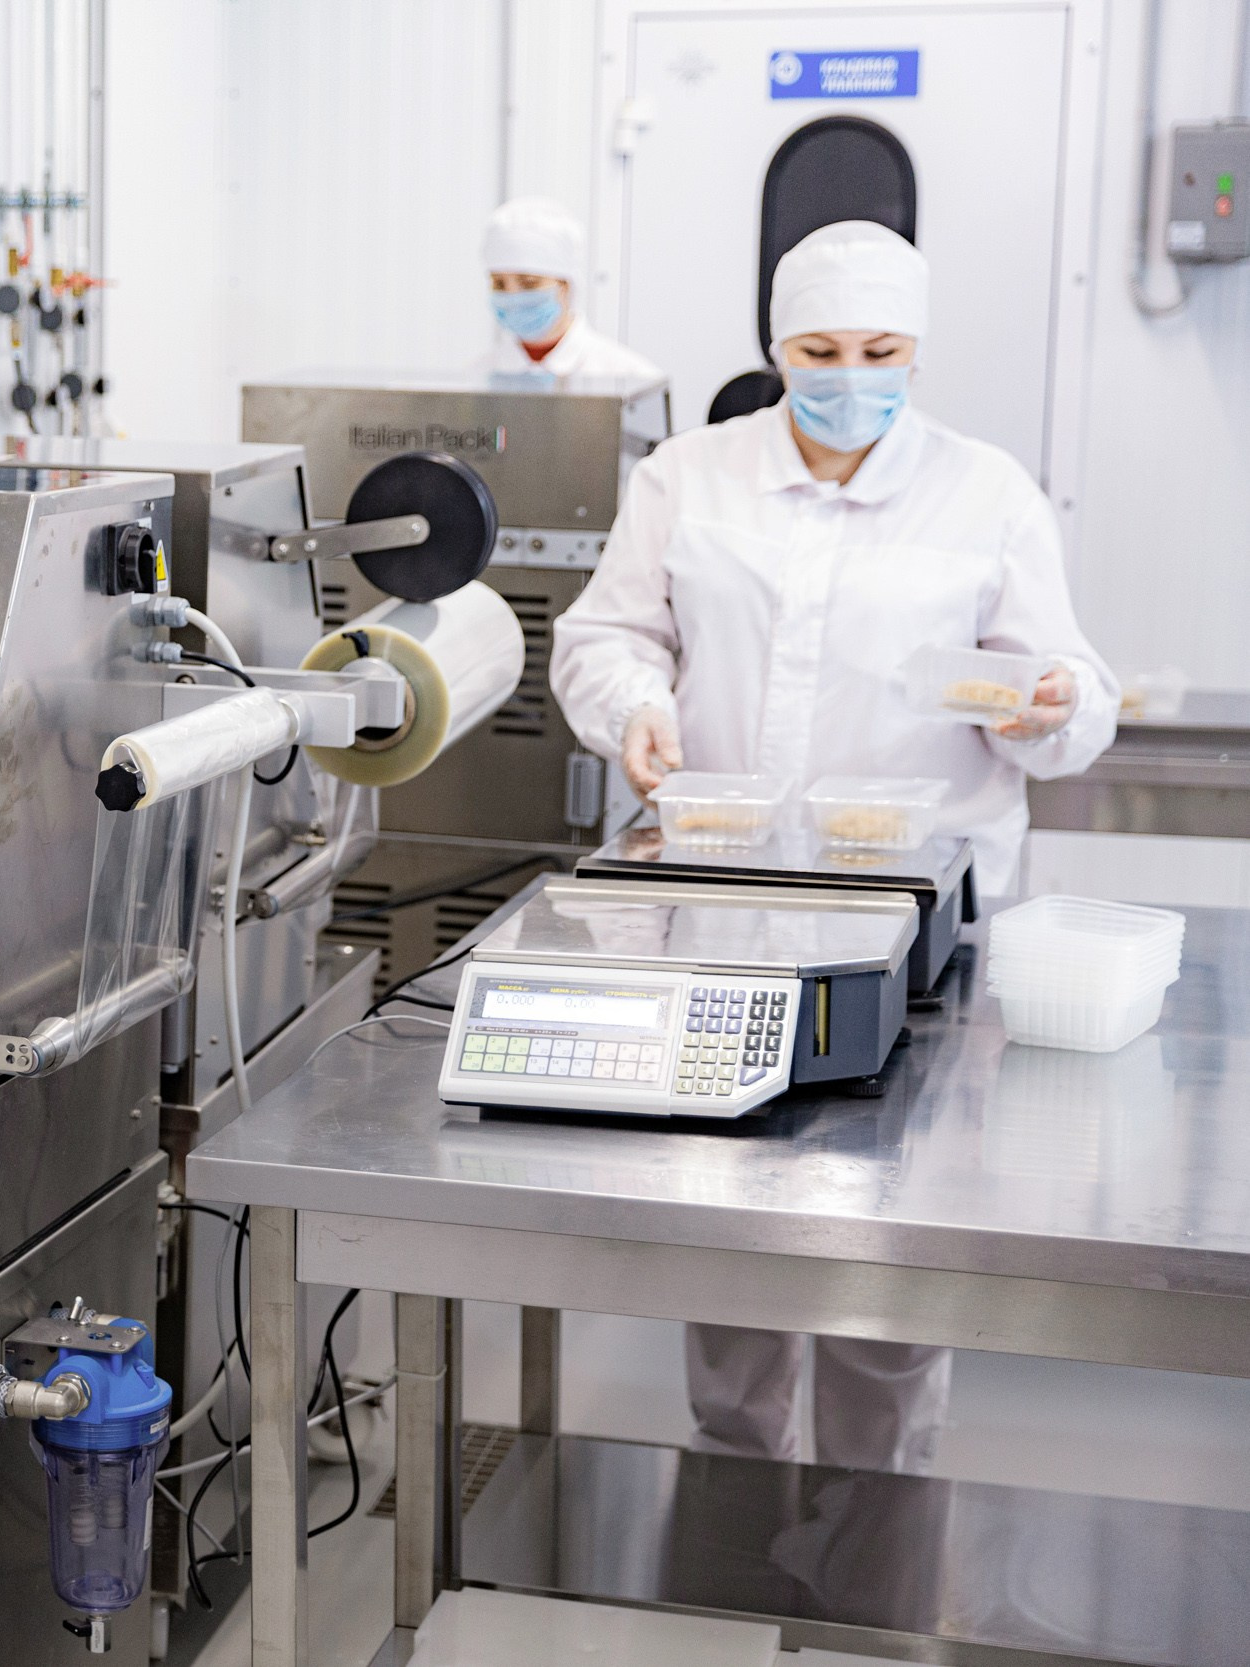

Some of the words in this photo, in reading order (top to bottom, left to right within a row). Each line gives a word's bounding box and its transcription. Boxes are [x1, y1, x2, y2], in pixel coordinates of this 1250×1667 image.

[349, 423, 421, 449] Italian
[425, 423, 492, 449] Pack
[497, 993, 535, 1005] 0.000
[565, 997, 596, 1008] 0.00
